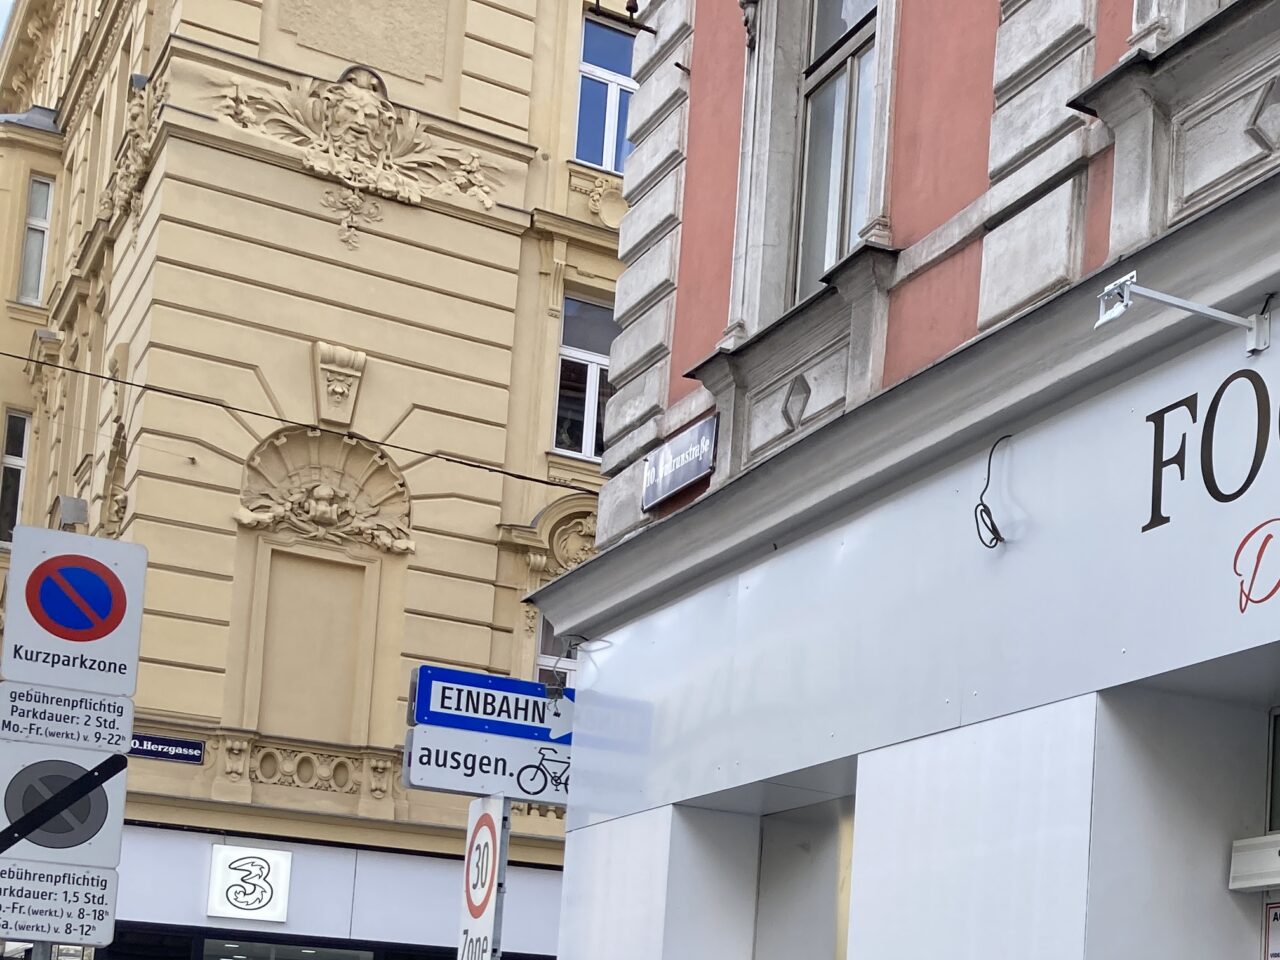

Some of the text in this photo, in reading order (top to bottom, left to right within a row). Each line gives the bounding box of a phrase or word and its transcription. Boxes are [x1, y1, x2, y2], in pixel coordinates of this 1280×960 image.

[13, 643, 128, 675] Kurzparkzone
[9, 689, 124, 718] gebührenpflichtig
[440, 685, 546, 725] EINBAHN
[1, 719, 44, 737] Mo.-Fr.
[44, 727, 81, 742] (werkt.)
[10, 704, 120, 731] Parkdauer: 2 Std.
[143, 741, 202, 757] Herzgasse
[418, 746, 515, 778] ausgen.
[0, 867, 108, 890] ebührenpflichtig
[472, 841, 489, 890] 30
[0, 885, 108, 906] rkdauer: 1,5 Std.
[226, 856, 274, 911] 3
[27, 905, 64, 919] (werkt.)
[14, 920, 51, 934] (werkt.)
